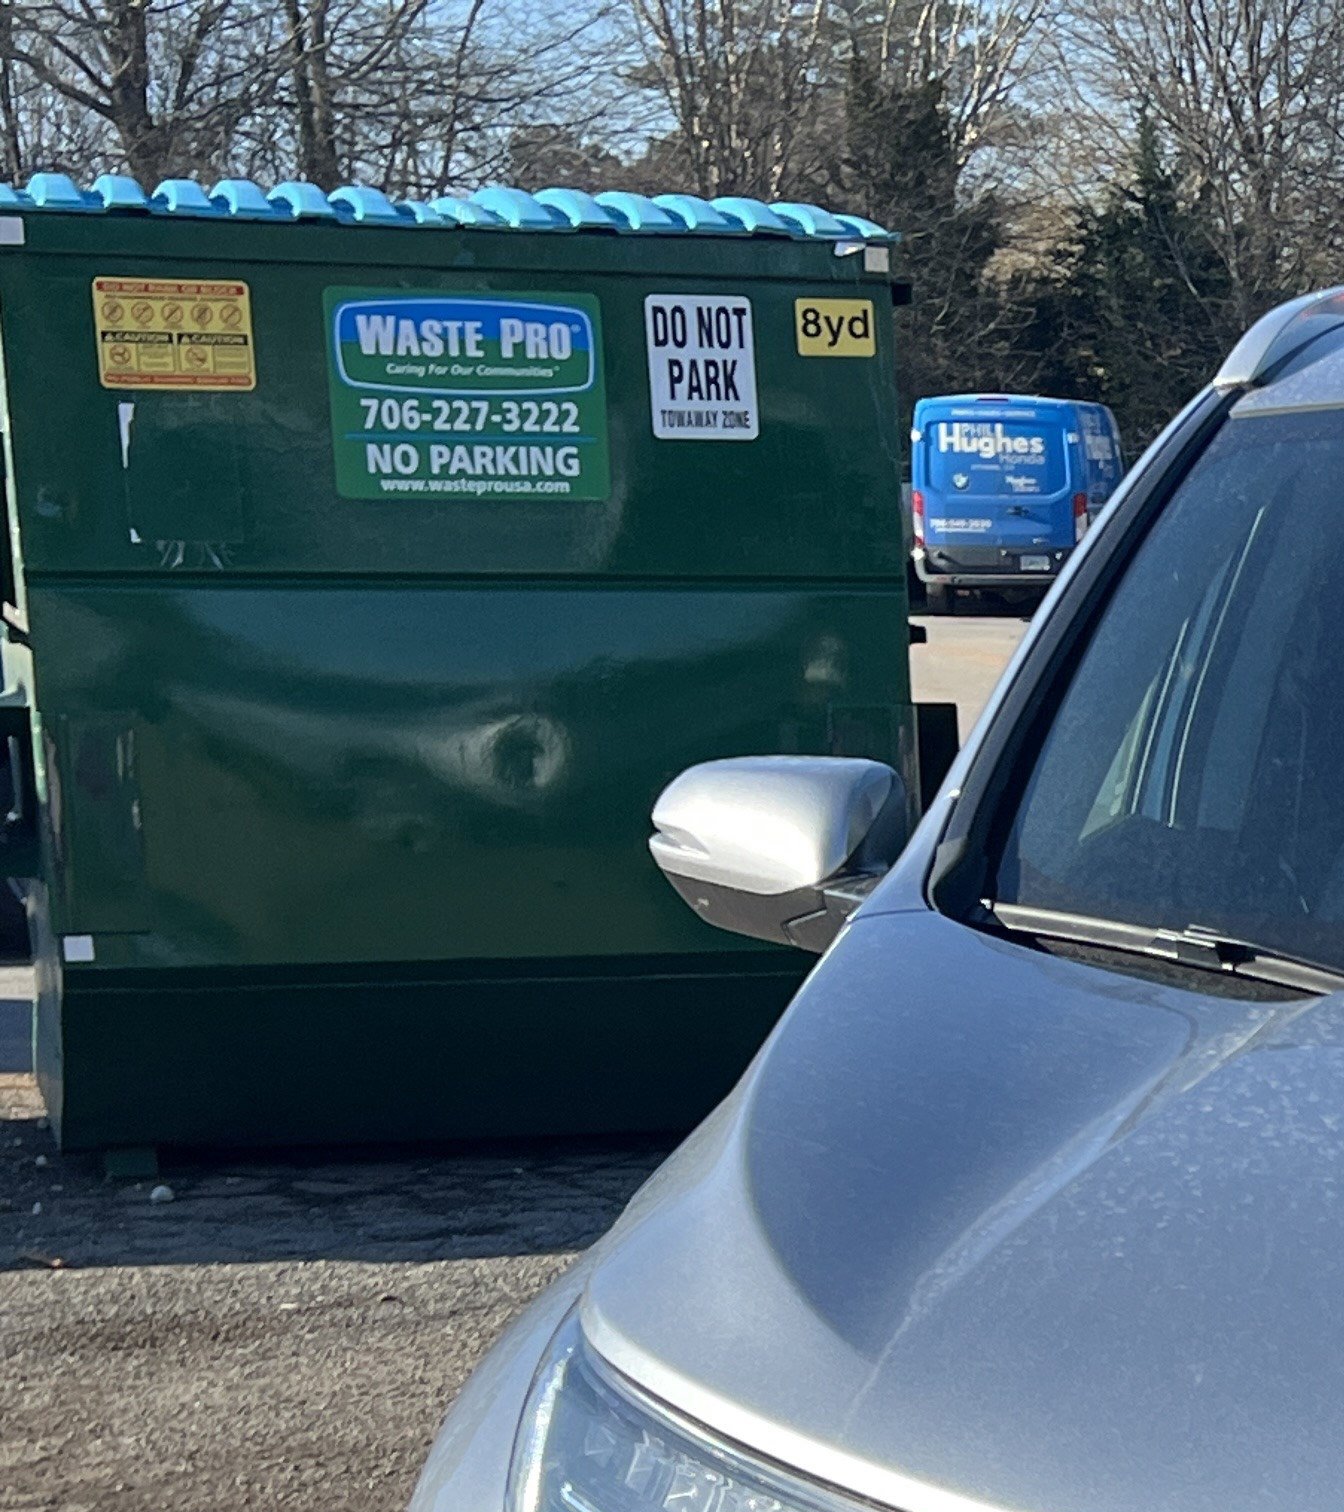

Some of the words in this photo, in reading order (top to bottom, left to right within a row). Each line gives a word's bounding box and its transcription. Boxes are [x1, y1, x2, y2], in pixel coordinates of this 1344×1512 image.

[355, 314, 485, 358] WASTE
[499, 318, 573, 360] PRO
[652, 305, 688, 349] DO
[696, 306, 748, 349] NOT
[801, 307, 871, 347] 8yd
[385, 363, 425, 377] Caring
[428, 364, 449, 376] For
[450, 365, 474, 376] Our
[476, 364, 554, 378] Communities
[668, 358, 741, 402] PARK
[359, 398, 581, 433] 706-227-3222
[661, 409, 718, 429] TOWAWAY
[722, 410, 751, 430] ZONE
[938, 421, 1045, 459] Hughes
[366, 443, 420, 475] NO
[429, 445, 581, 477] PARKING
[380, 477, 572, 496] www.wasteprousa.com
